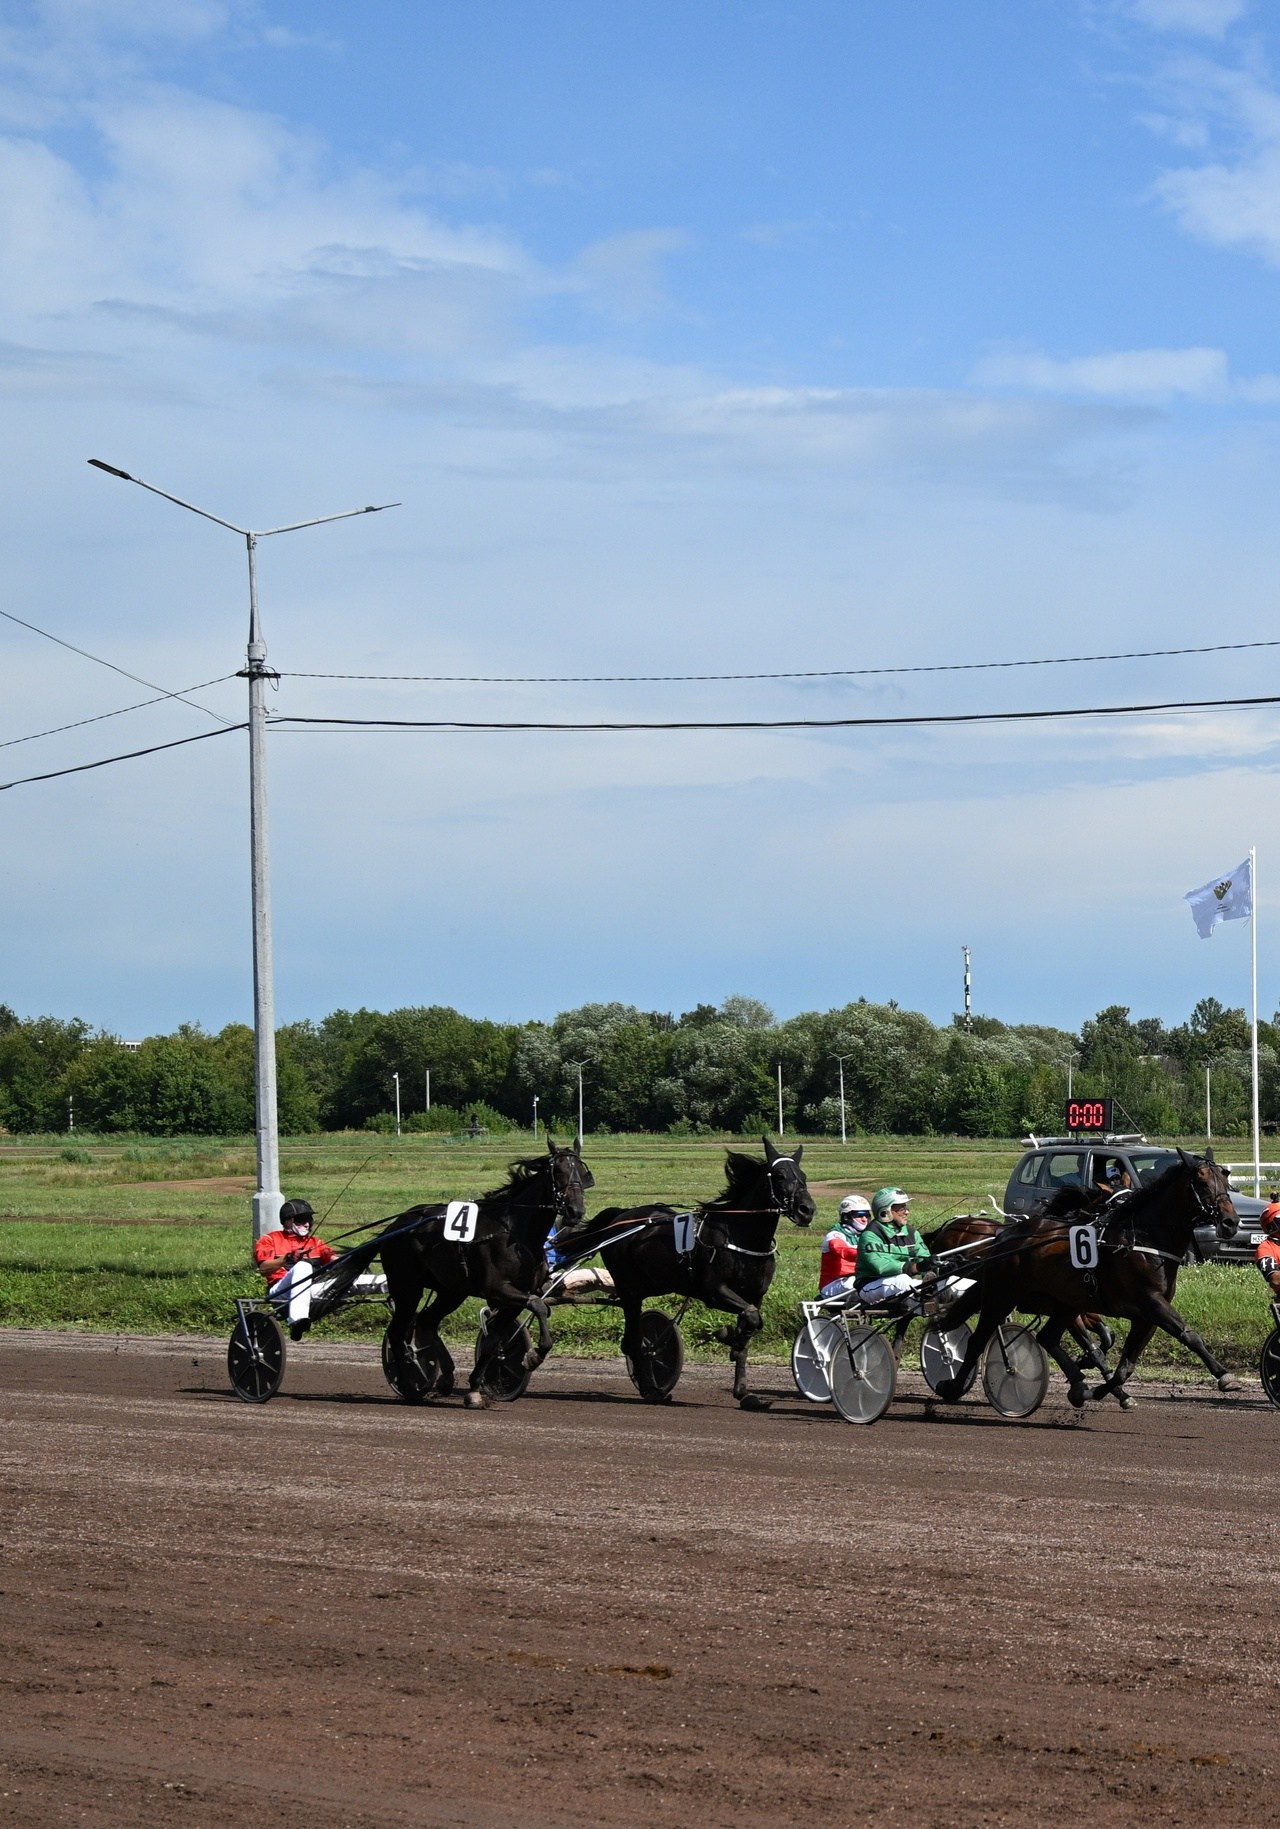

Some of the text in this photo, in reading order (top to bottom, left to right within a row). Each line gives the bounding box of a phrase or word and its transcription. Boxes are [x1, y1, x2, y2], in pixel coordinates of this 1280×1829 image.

[1069, 1103, 1103, 1127] 0:00
[450, 1205, 470, 1239] 4
[677, 1215, 690, 1250] 7
[1075, 1228, 1092, 1266] 6
